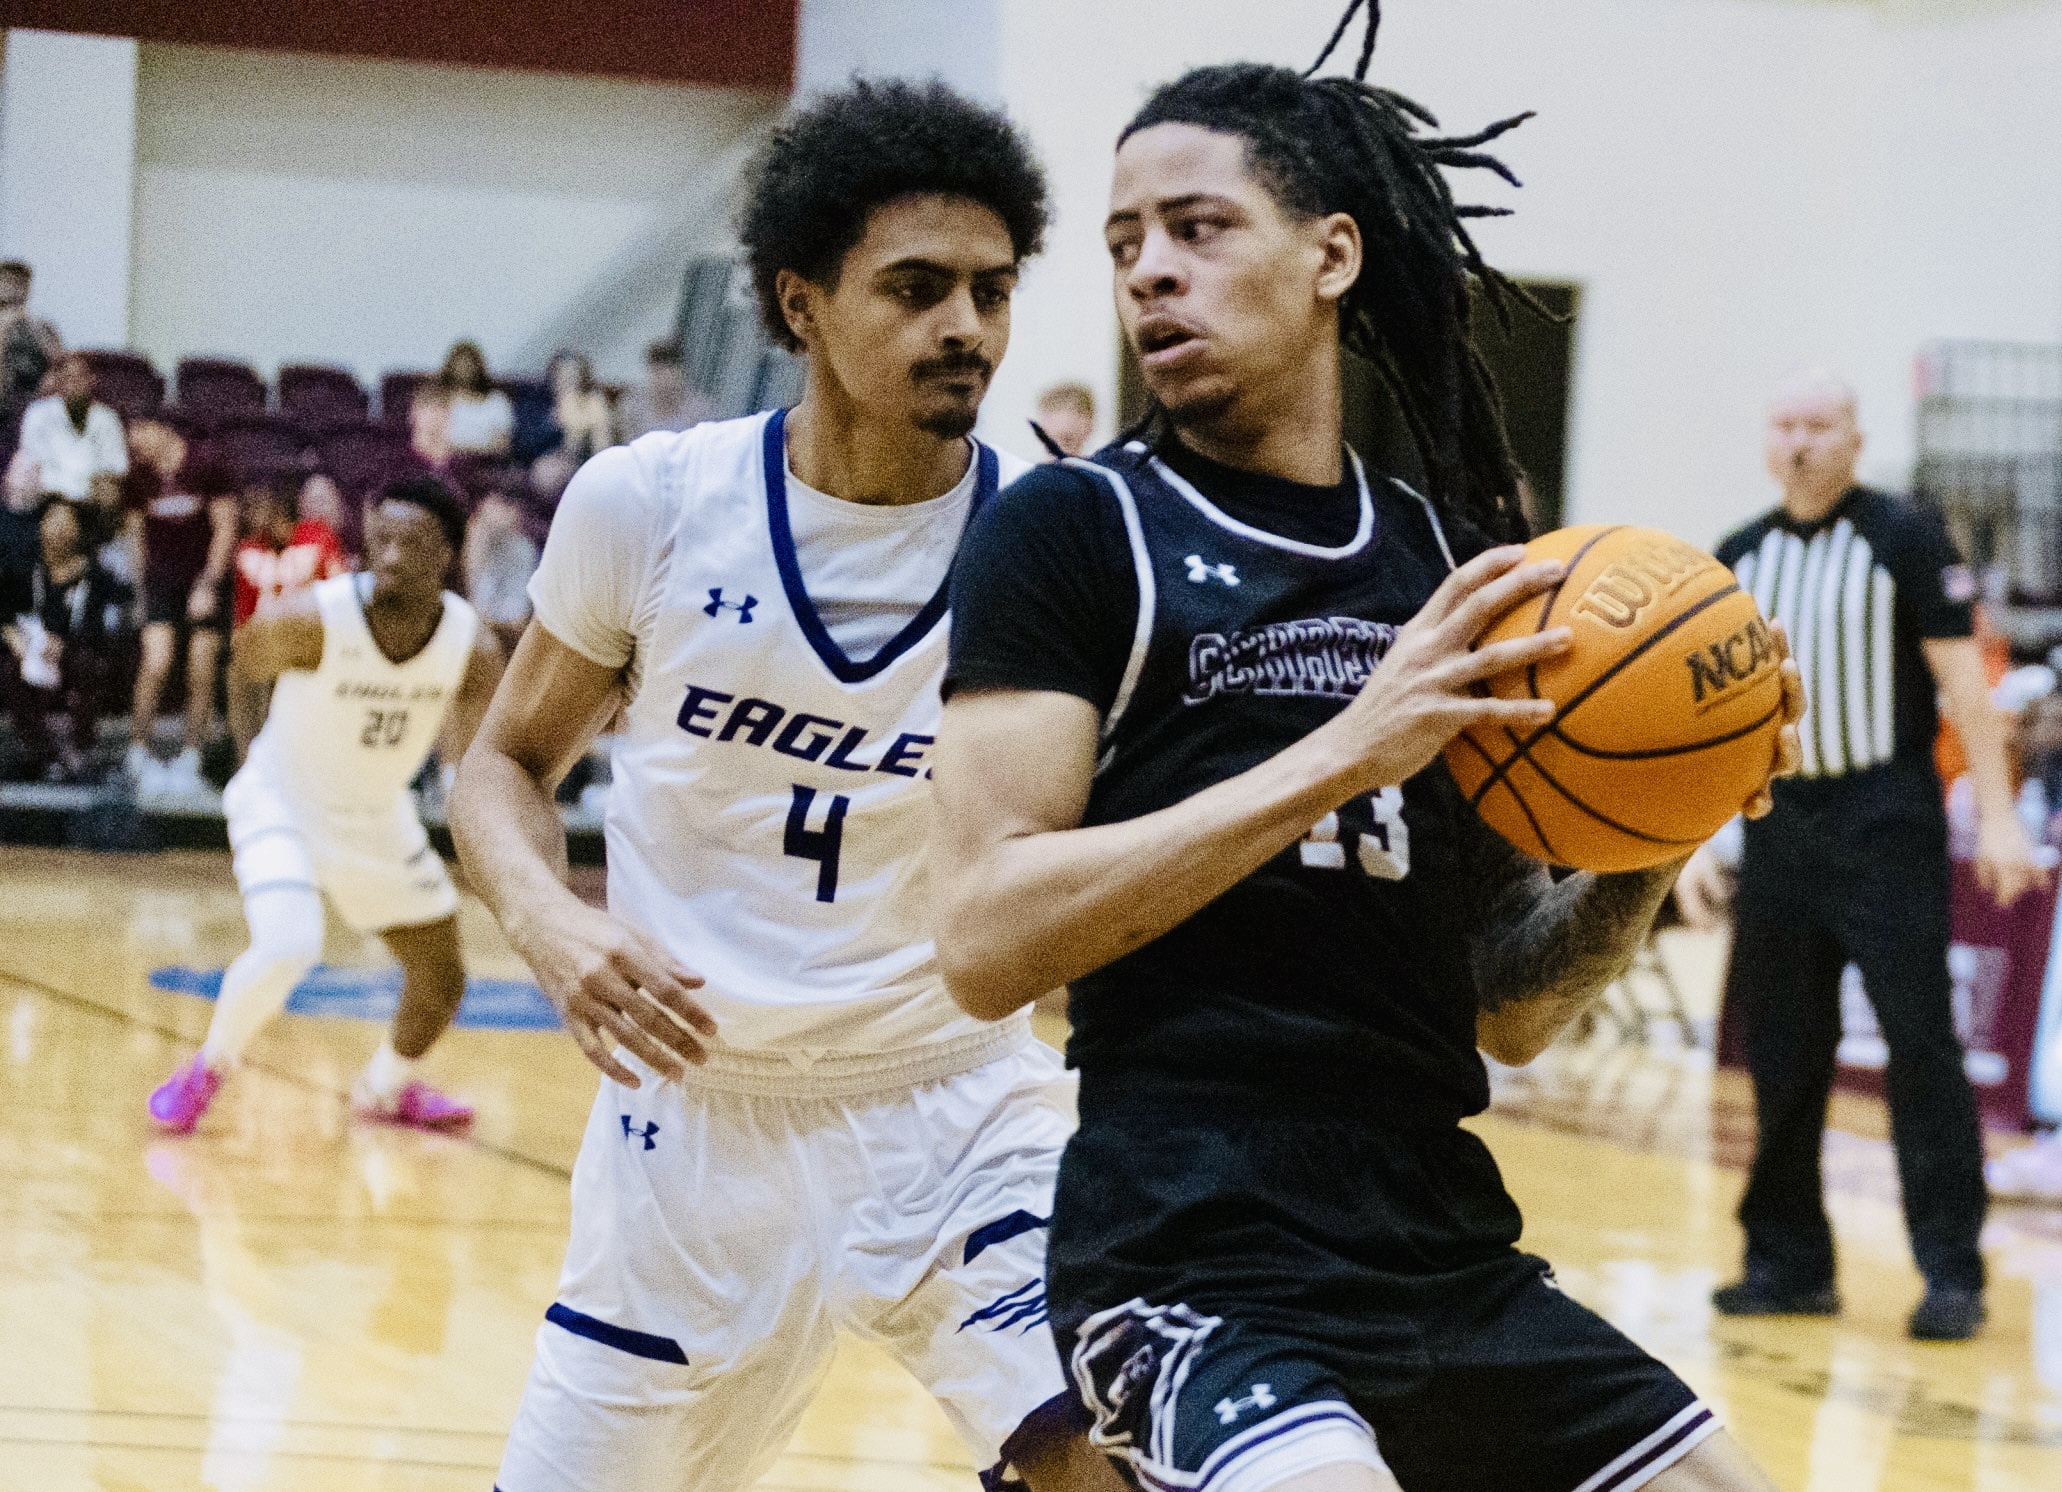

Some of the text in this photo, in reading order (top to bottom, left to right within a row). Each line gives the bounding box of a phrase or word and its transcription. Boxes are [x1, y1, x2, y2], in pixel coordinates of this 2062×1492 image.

[1685, 613, 1773, 703] NCA
[360, 707, 409, 748] 20
[676, 684, 935, 780] EAGLE
[783, 783, 850, 903] 4
